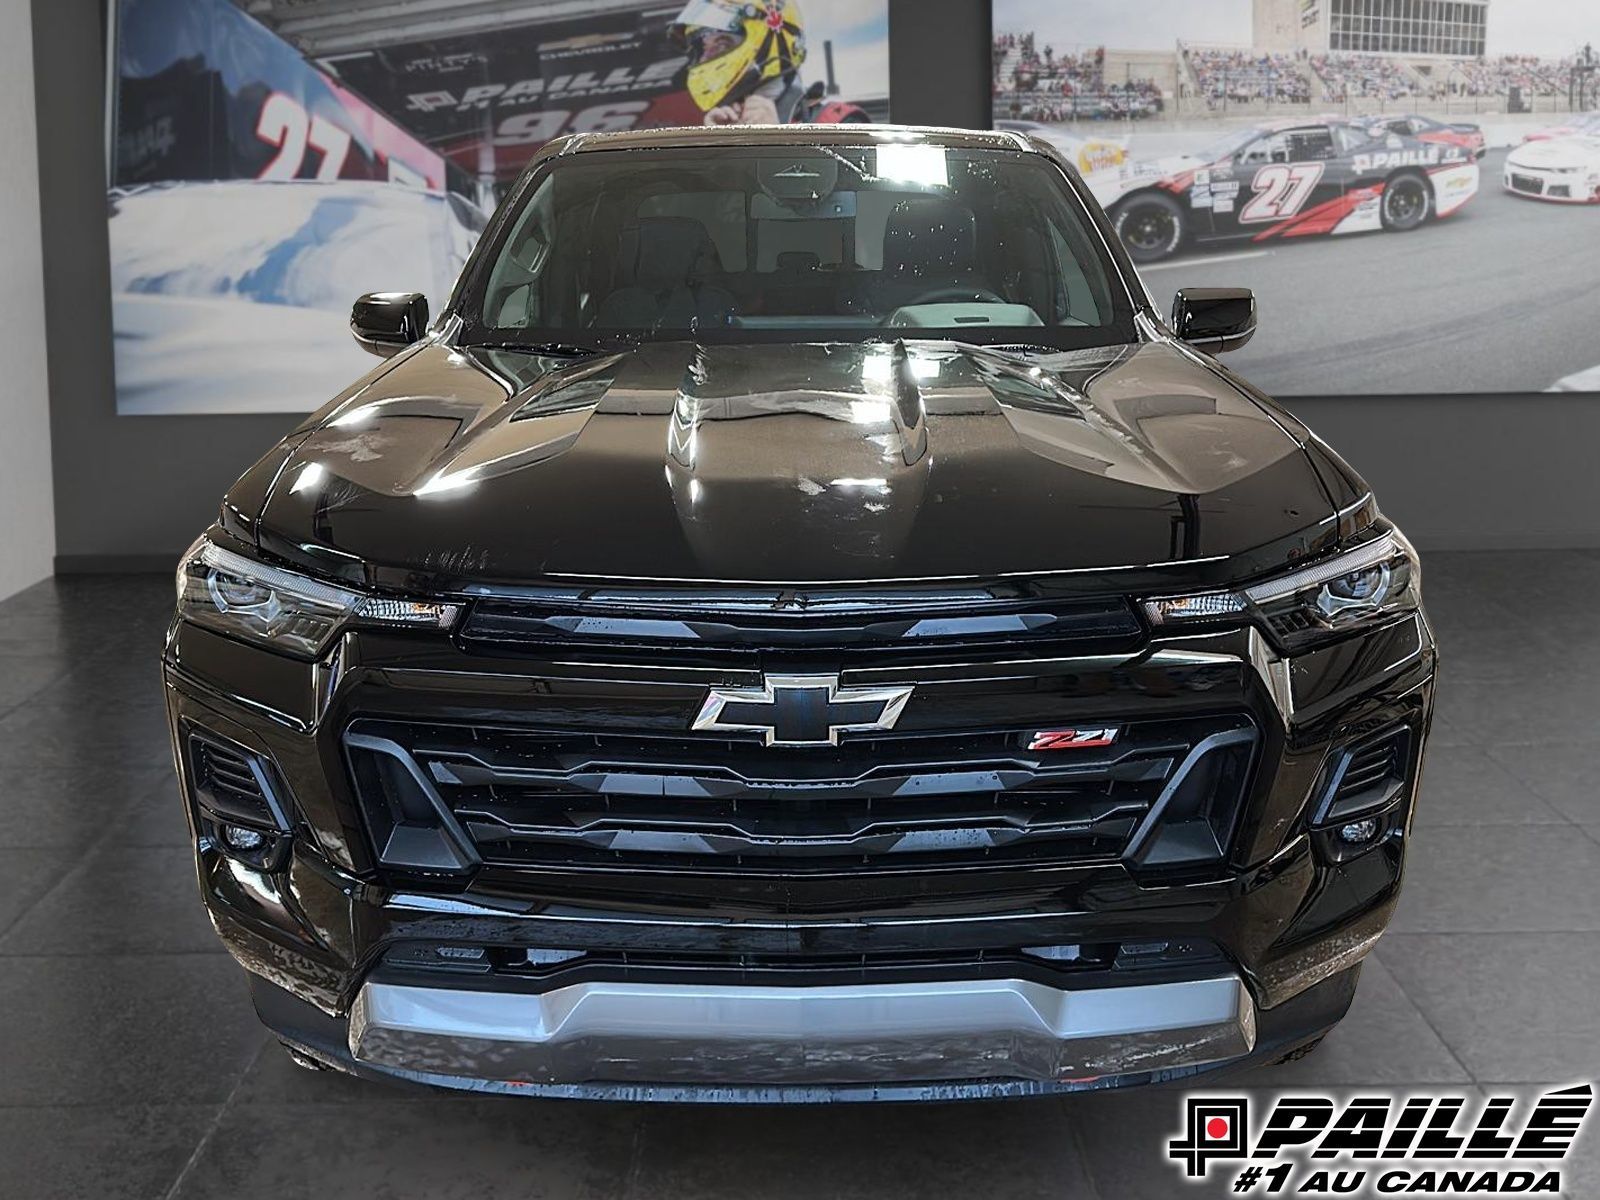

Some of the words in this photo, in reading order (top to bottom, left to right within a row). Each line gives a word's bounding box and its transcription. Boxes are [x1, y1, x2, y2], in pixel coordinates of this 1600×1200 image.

[254, 91, 351, 181] 27
[493, 101, 650, 147] 96
[1239, 161, 1325, 224] 27
